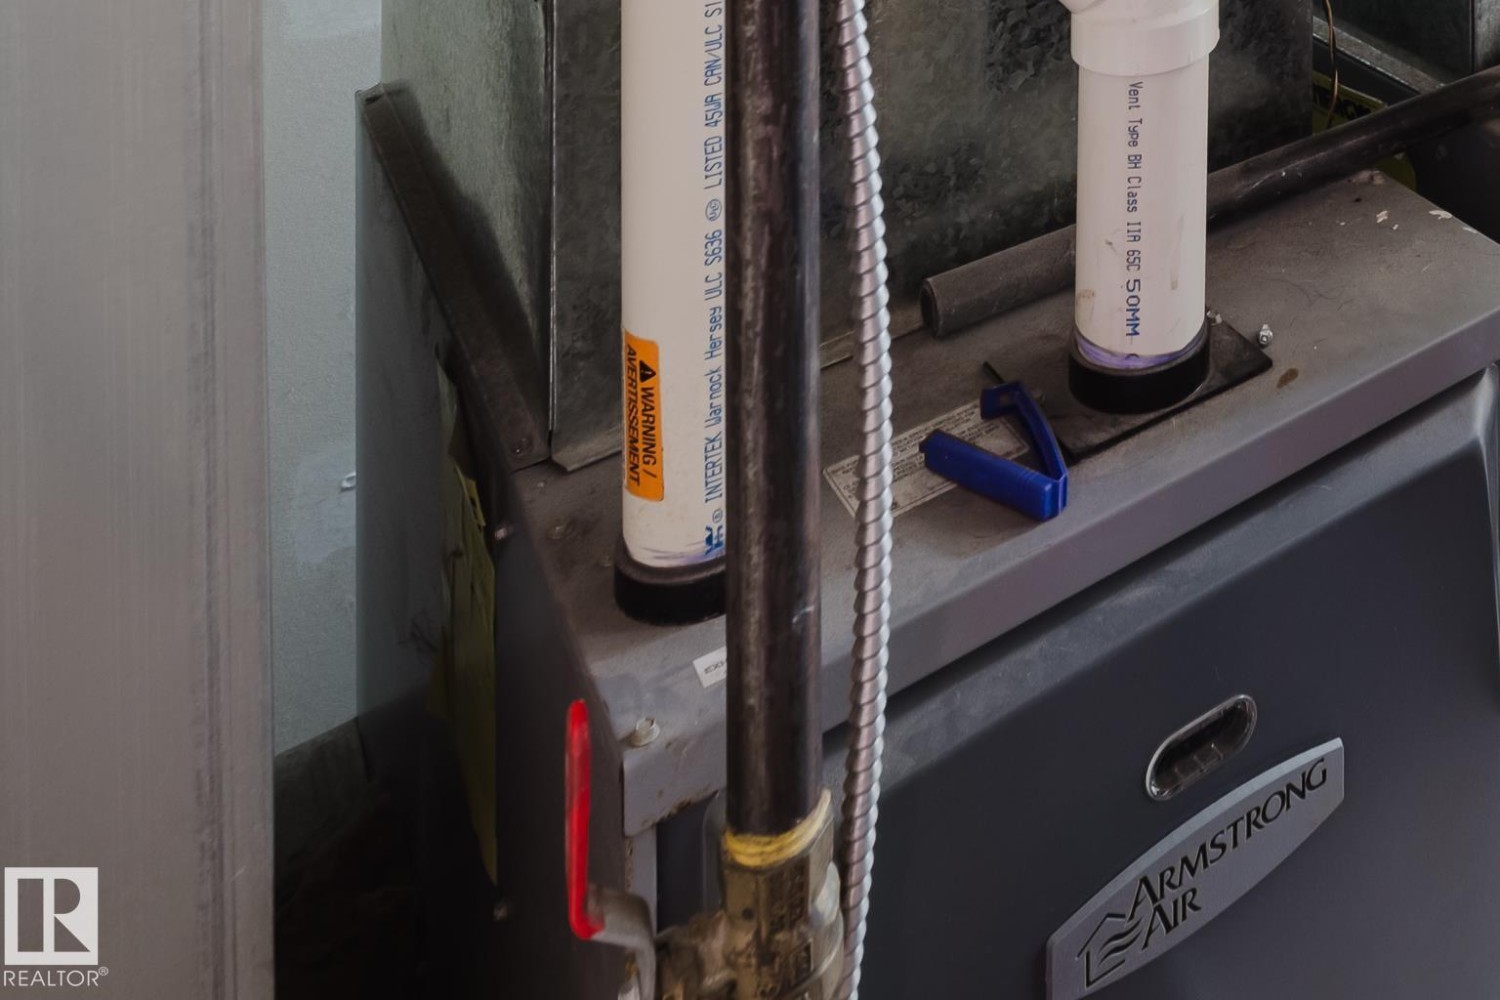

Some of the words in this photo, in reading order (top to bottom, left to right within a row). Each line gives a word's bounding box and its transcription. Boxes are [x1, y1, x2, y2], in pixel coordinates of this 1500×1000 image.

[704, 25, 722, 86] CAN/ULC
[1129, 82, 1143, 110] Vent
[1128, 118, 1142, 147] Type
[704, 136, 722, 189] LISTED
[1128, 154, 1142, 169] BH
[1127, 176, 1141, 212] Class
[704, 230, 722, 266] S636
[1127, 222, 1141, 242] IIA
[705, 272, 722, 301] ULC
[1126, 250, 1141, 271] 65C
[705, 306, 722, 360] Hersey
[1126, 279, 1140, 336] 50MM
[627, 344, 641, 486] AVERTISSEMENT
[705, 366, 722, 428] Warnock
[642, 387, 657, 464] WARNING
[704, 434, 722, 503] INTERTEK
[1125, 757, 1328, 921] ARMSTRONG
[1142, 886, 1201, 950] AIR
